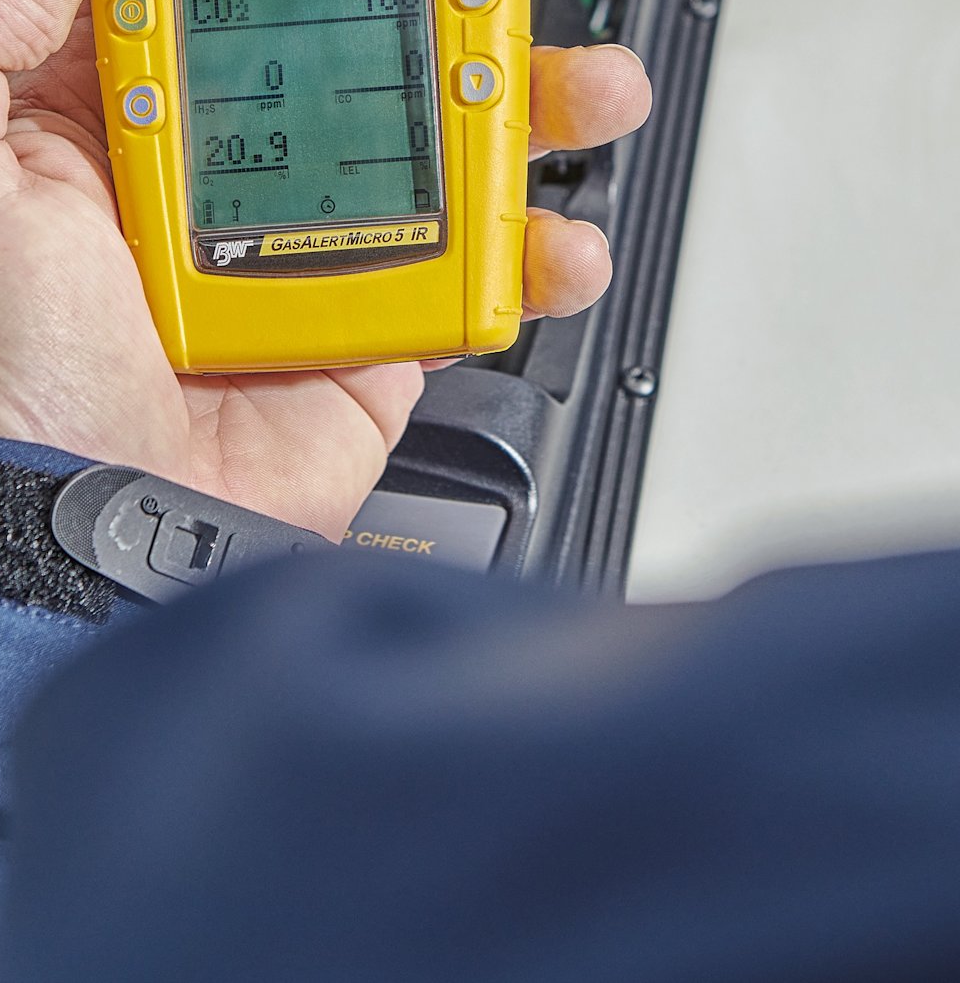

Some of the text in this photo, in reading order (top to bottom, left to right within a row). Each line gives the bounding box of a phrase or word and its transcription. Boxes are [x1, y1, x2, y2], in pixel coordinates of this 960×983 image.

[396, 19, 418, 30] ppm
[265, 49, 423, 90] 0 0
[338, 90, 423, 104] CO ppm
[260, 101, 282, 111] ppm
[206, 121, 429, 166] 20.9 0
[342, 165, 360, 175] LEL
[394, 228, 405, 242] 5
[213, 240, 253, 266] BW
[356, 531, 436, 555] CHECK
